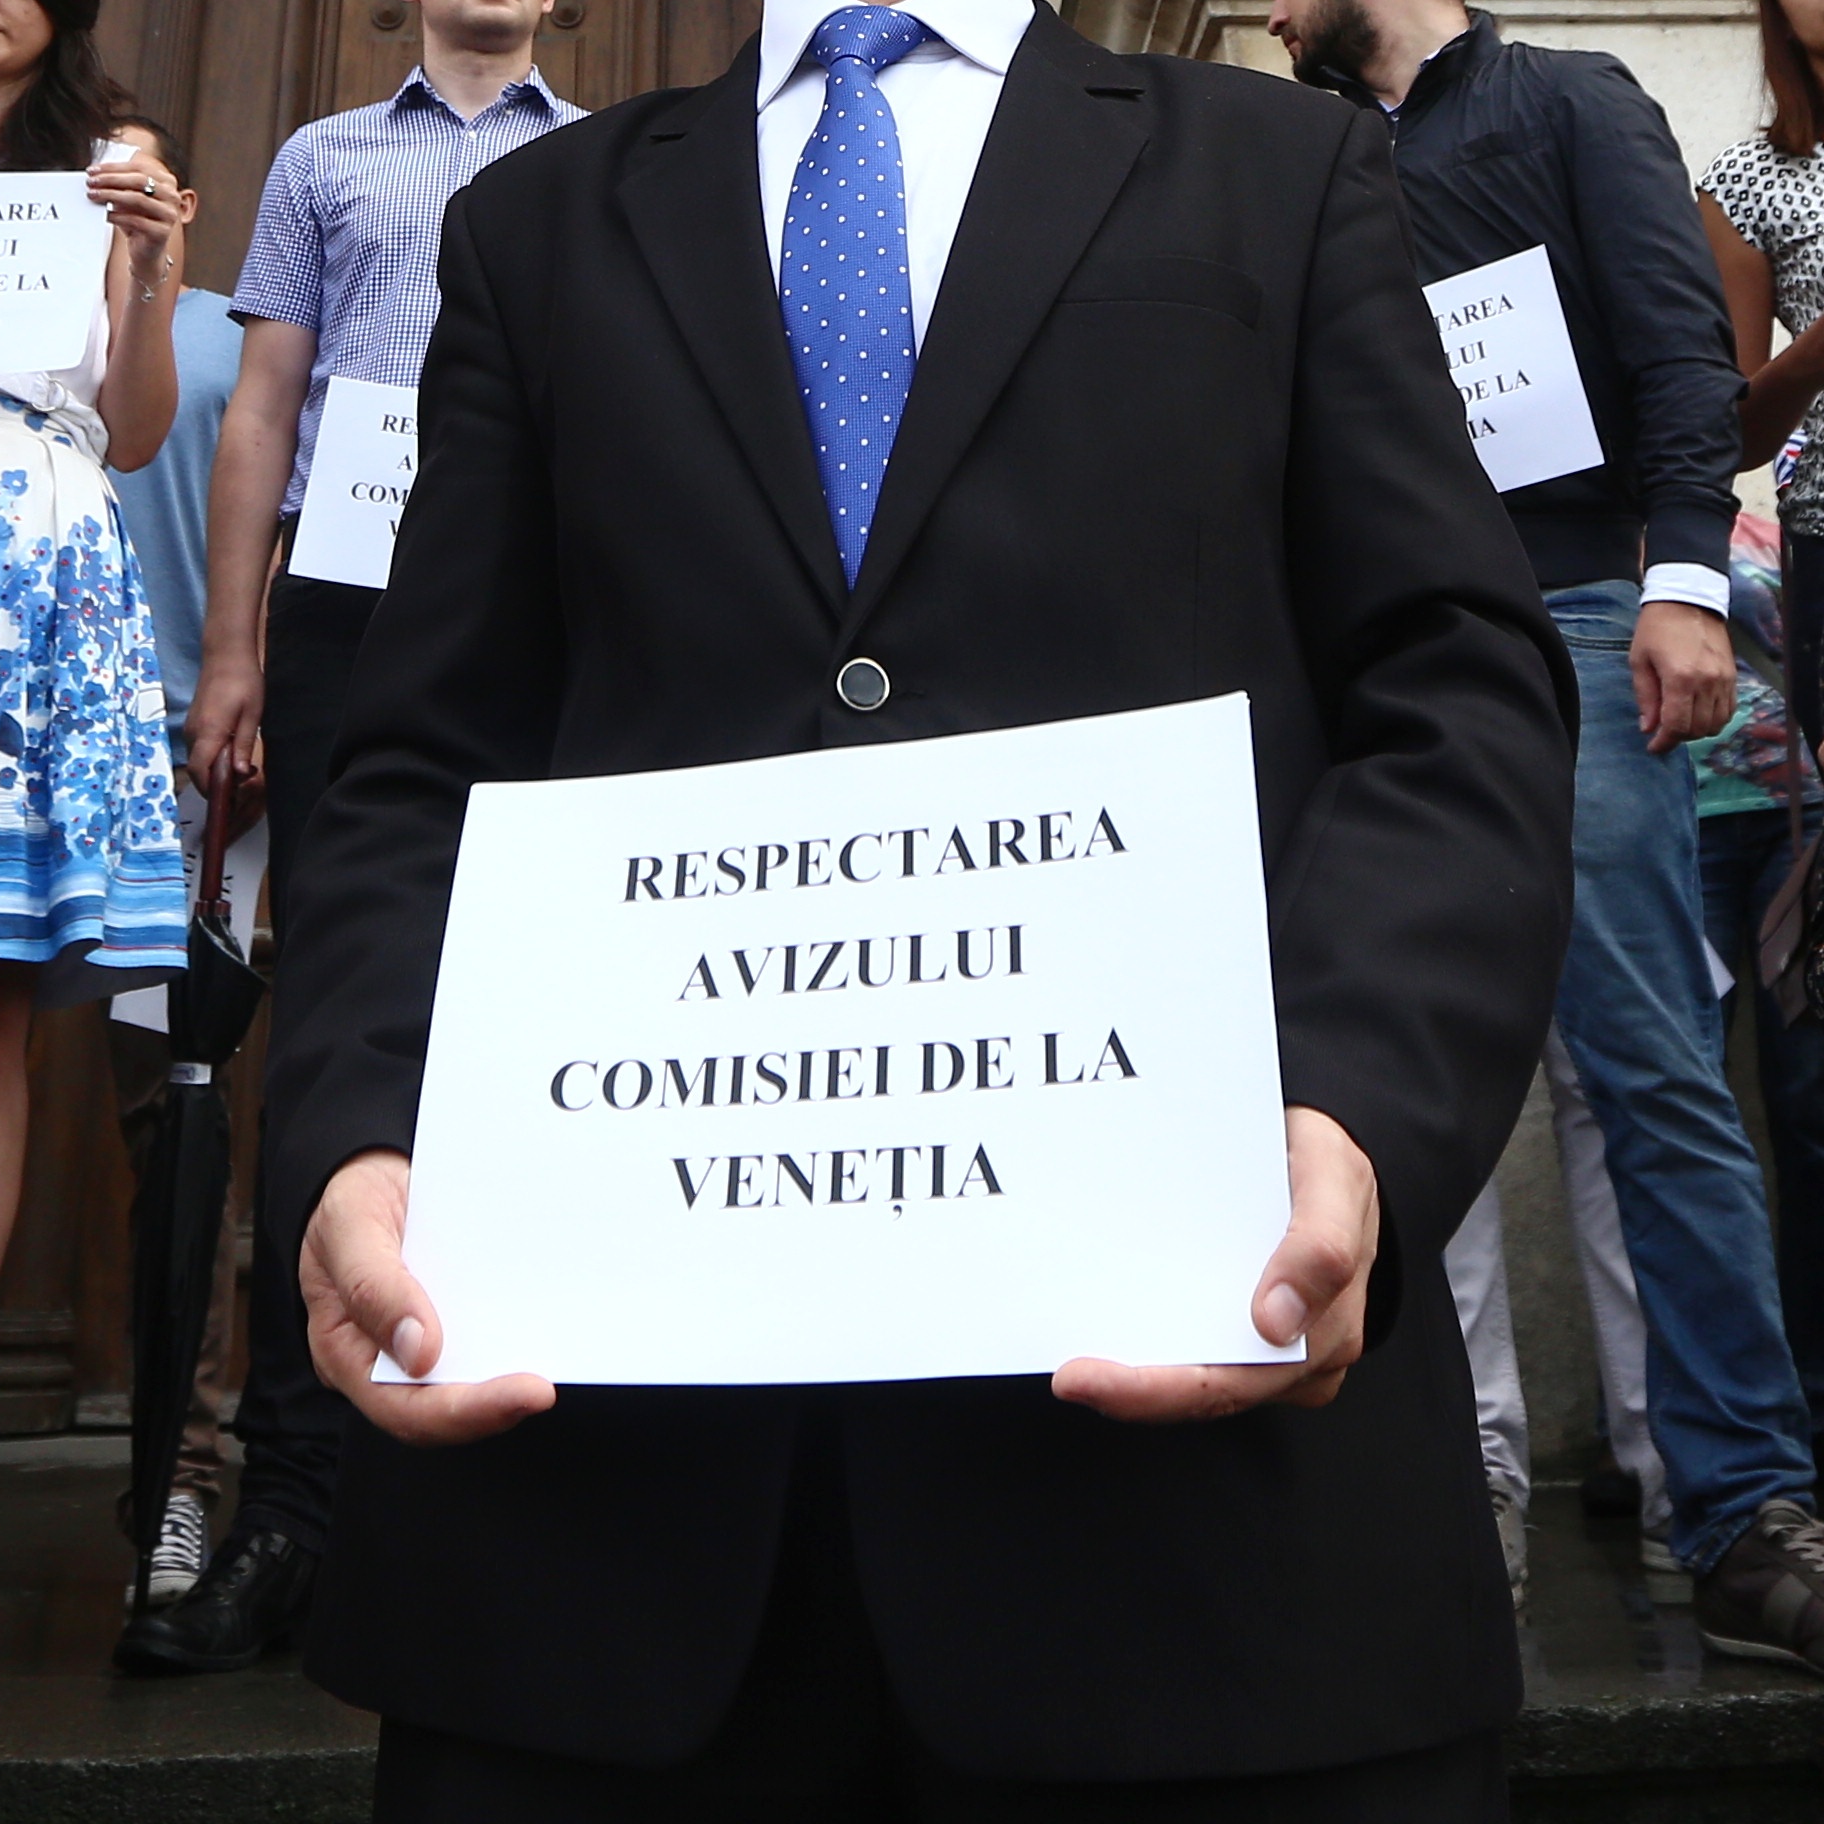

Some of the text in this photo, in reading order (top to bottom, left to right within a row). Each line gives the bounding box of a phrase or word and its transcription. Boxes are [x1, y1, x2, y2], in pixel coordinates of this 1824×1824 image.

[17, 274, 50, 291] LA
[1496, 369, 1532, 394] LA
[381, 414, 418, 436] RE
[621, 806, 1127, 902] RESPECTAREA
[678, 924, 1025, 1001] AVIZULUI
[550, 1027, 1138, 1111] COMISIEI DE LA
[672, 1142, 1003, 1221] VENEȚIA
